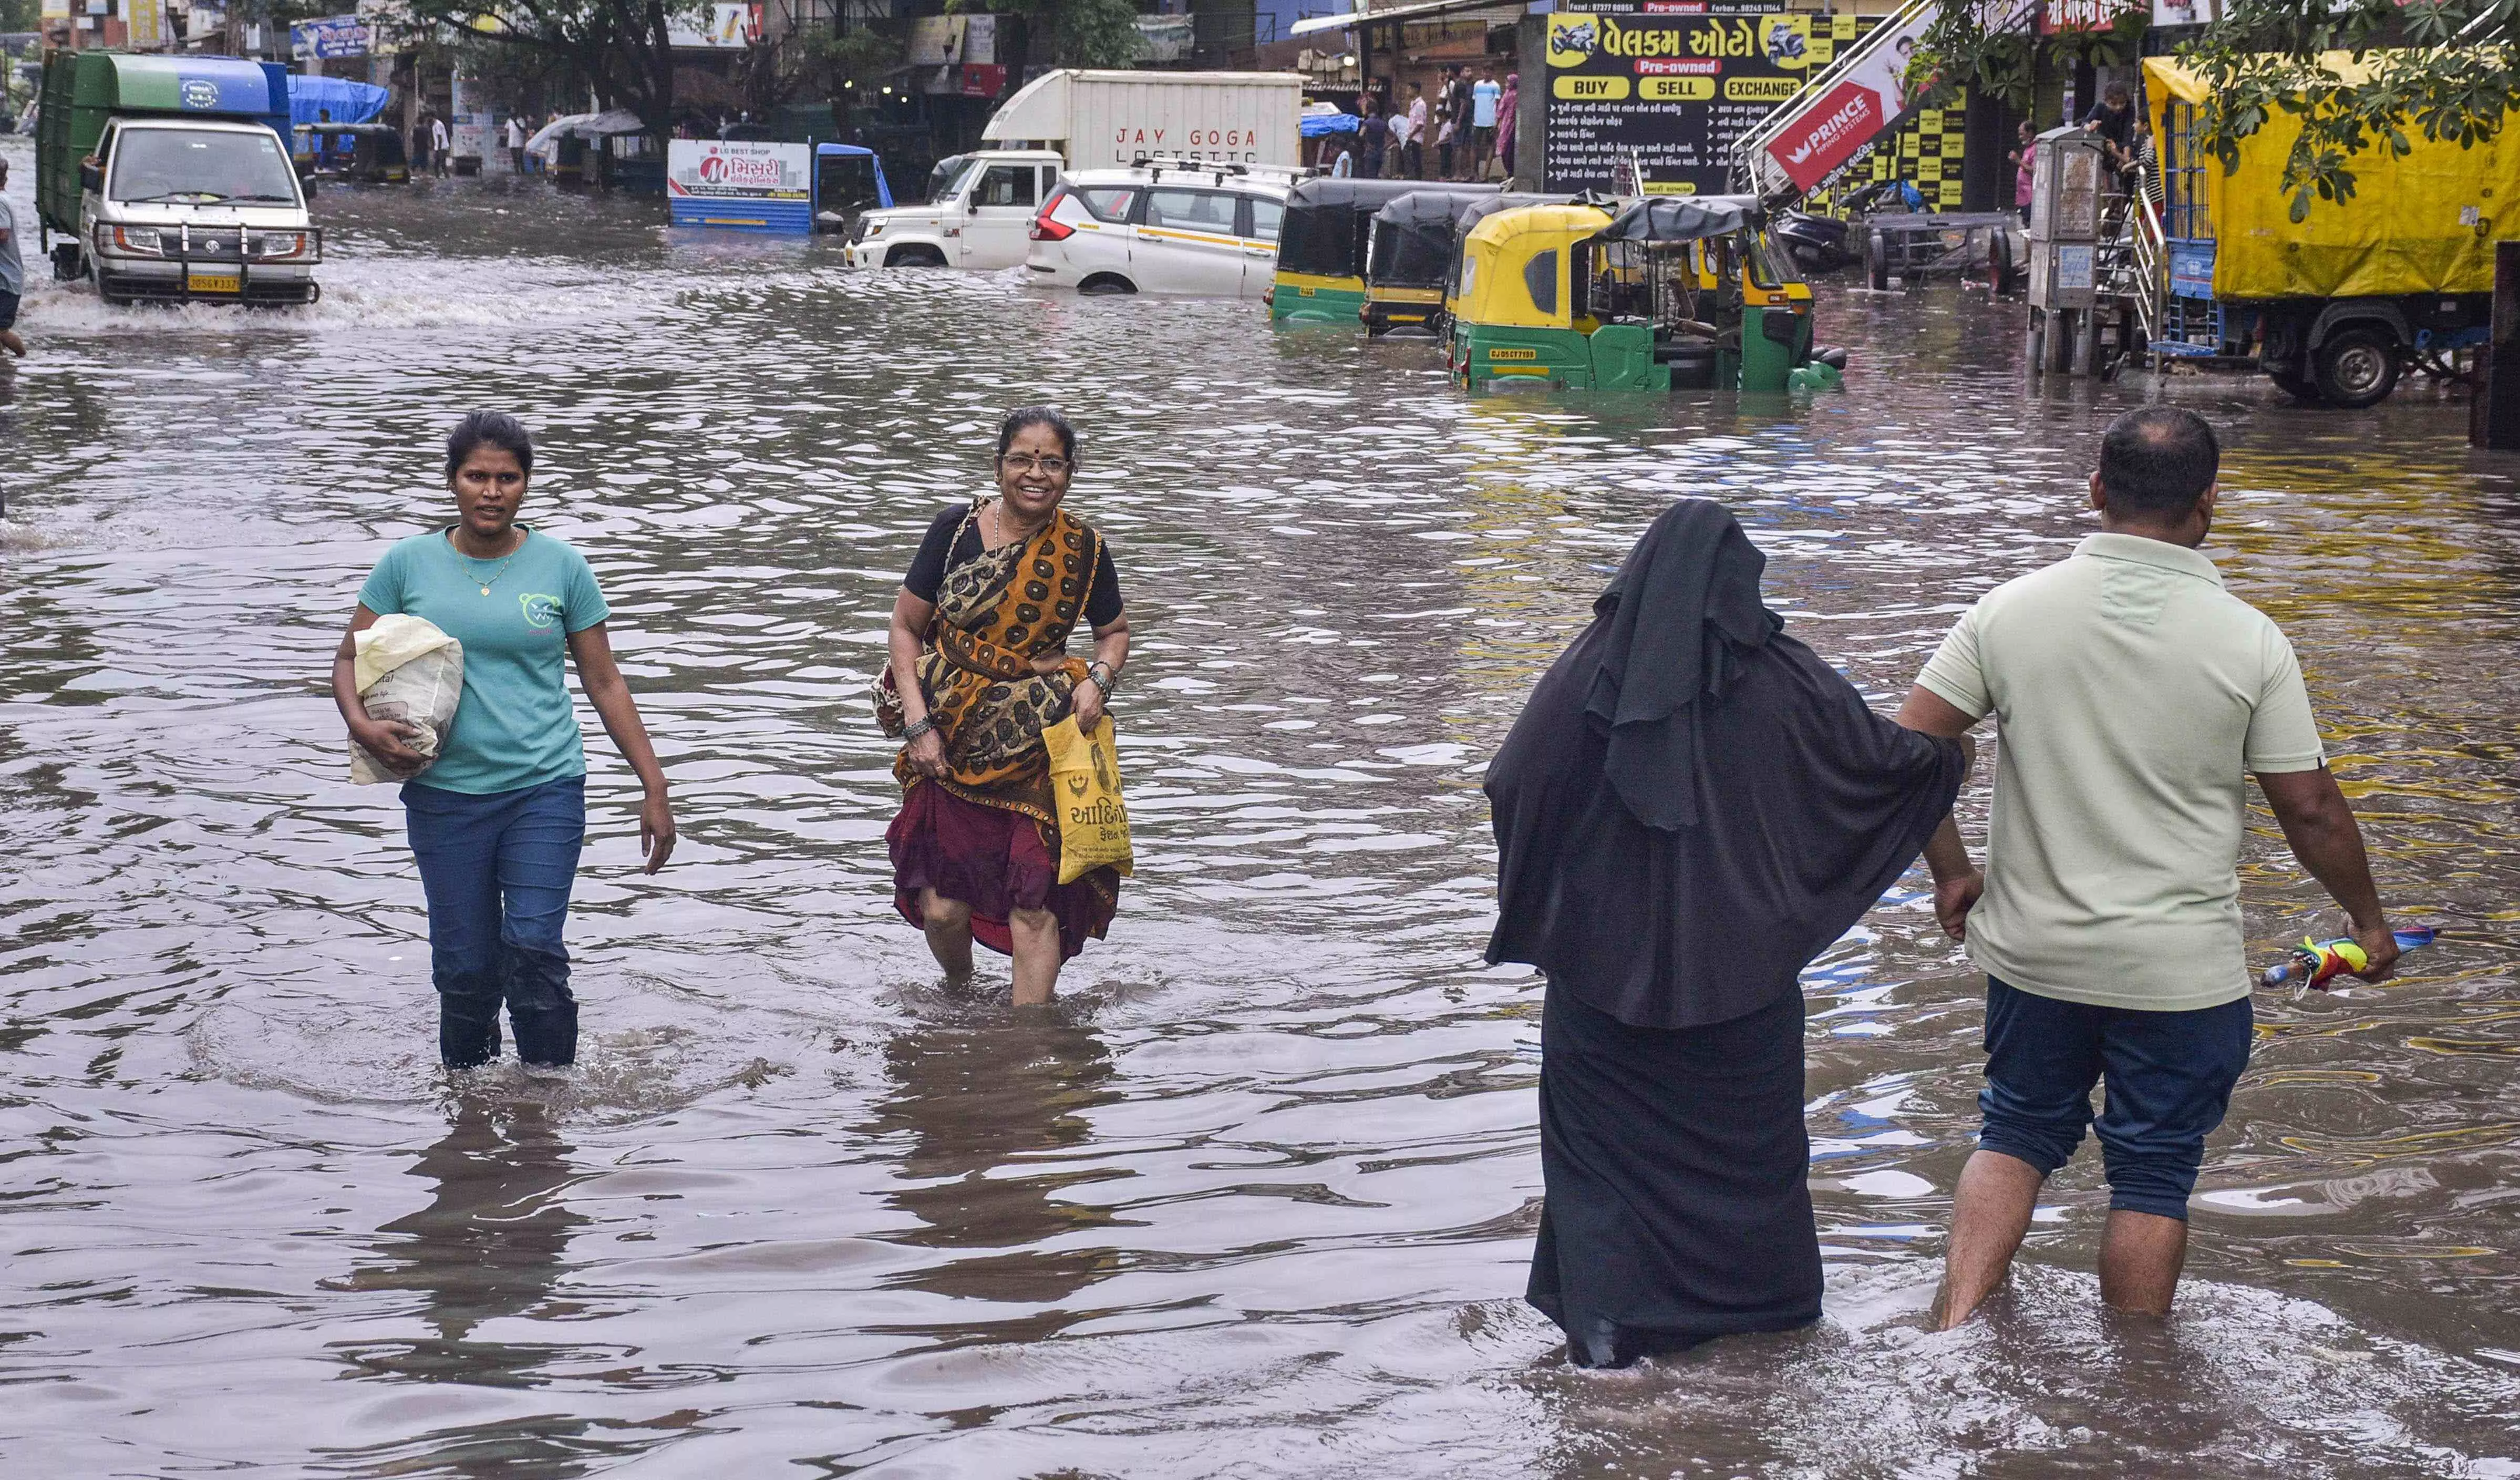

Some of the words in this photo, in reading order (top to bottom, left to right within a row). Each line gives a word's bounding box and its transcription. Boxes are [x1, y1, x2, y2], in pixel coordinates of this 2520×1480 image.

[1648, 4, 1702, 12] Pre-owned
[1603, 18, 1680, 56] વેલકમ
[1689, 18, 1753, 56] ઓટો
[1640, 60, 1715, 74] Pre-owned
[1574, 81, 1608, 94] BUY
[1657, 81, 1696, 95] SELL
[1728, 81, 1796, 96] EXCHANGE
[1809, 94, 1866, 148] PRINCE
[1117, 129, 1164, 143] JAY
[1190, 130, 1254, 146] GOGA
[1816, 134, 1840, 155] PIPING
[1841, 108, 1870, 135] SYSTEMS
[731, 157, 779, 175] મિસરી
